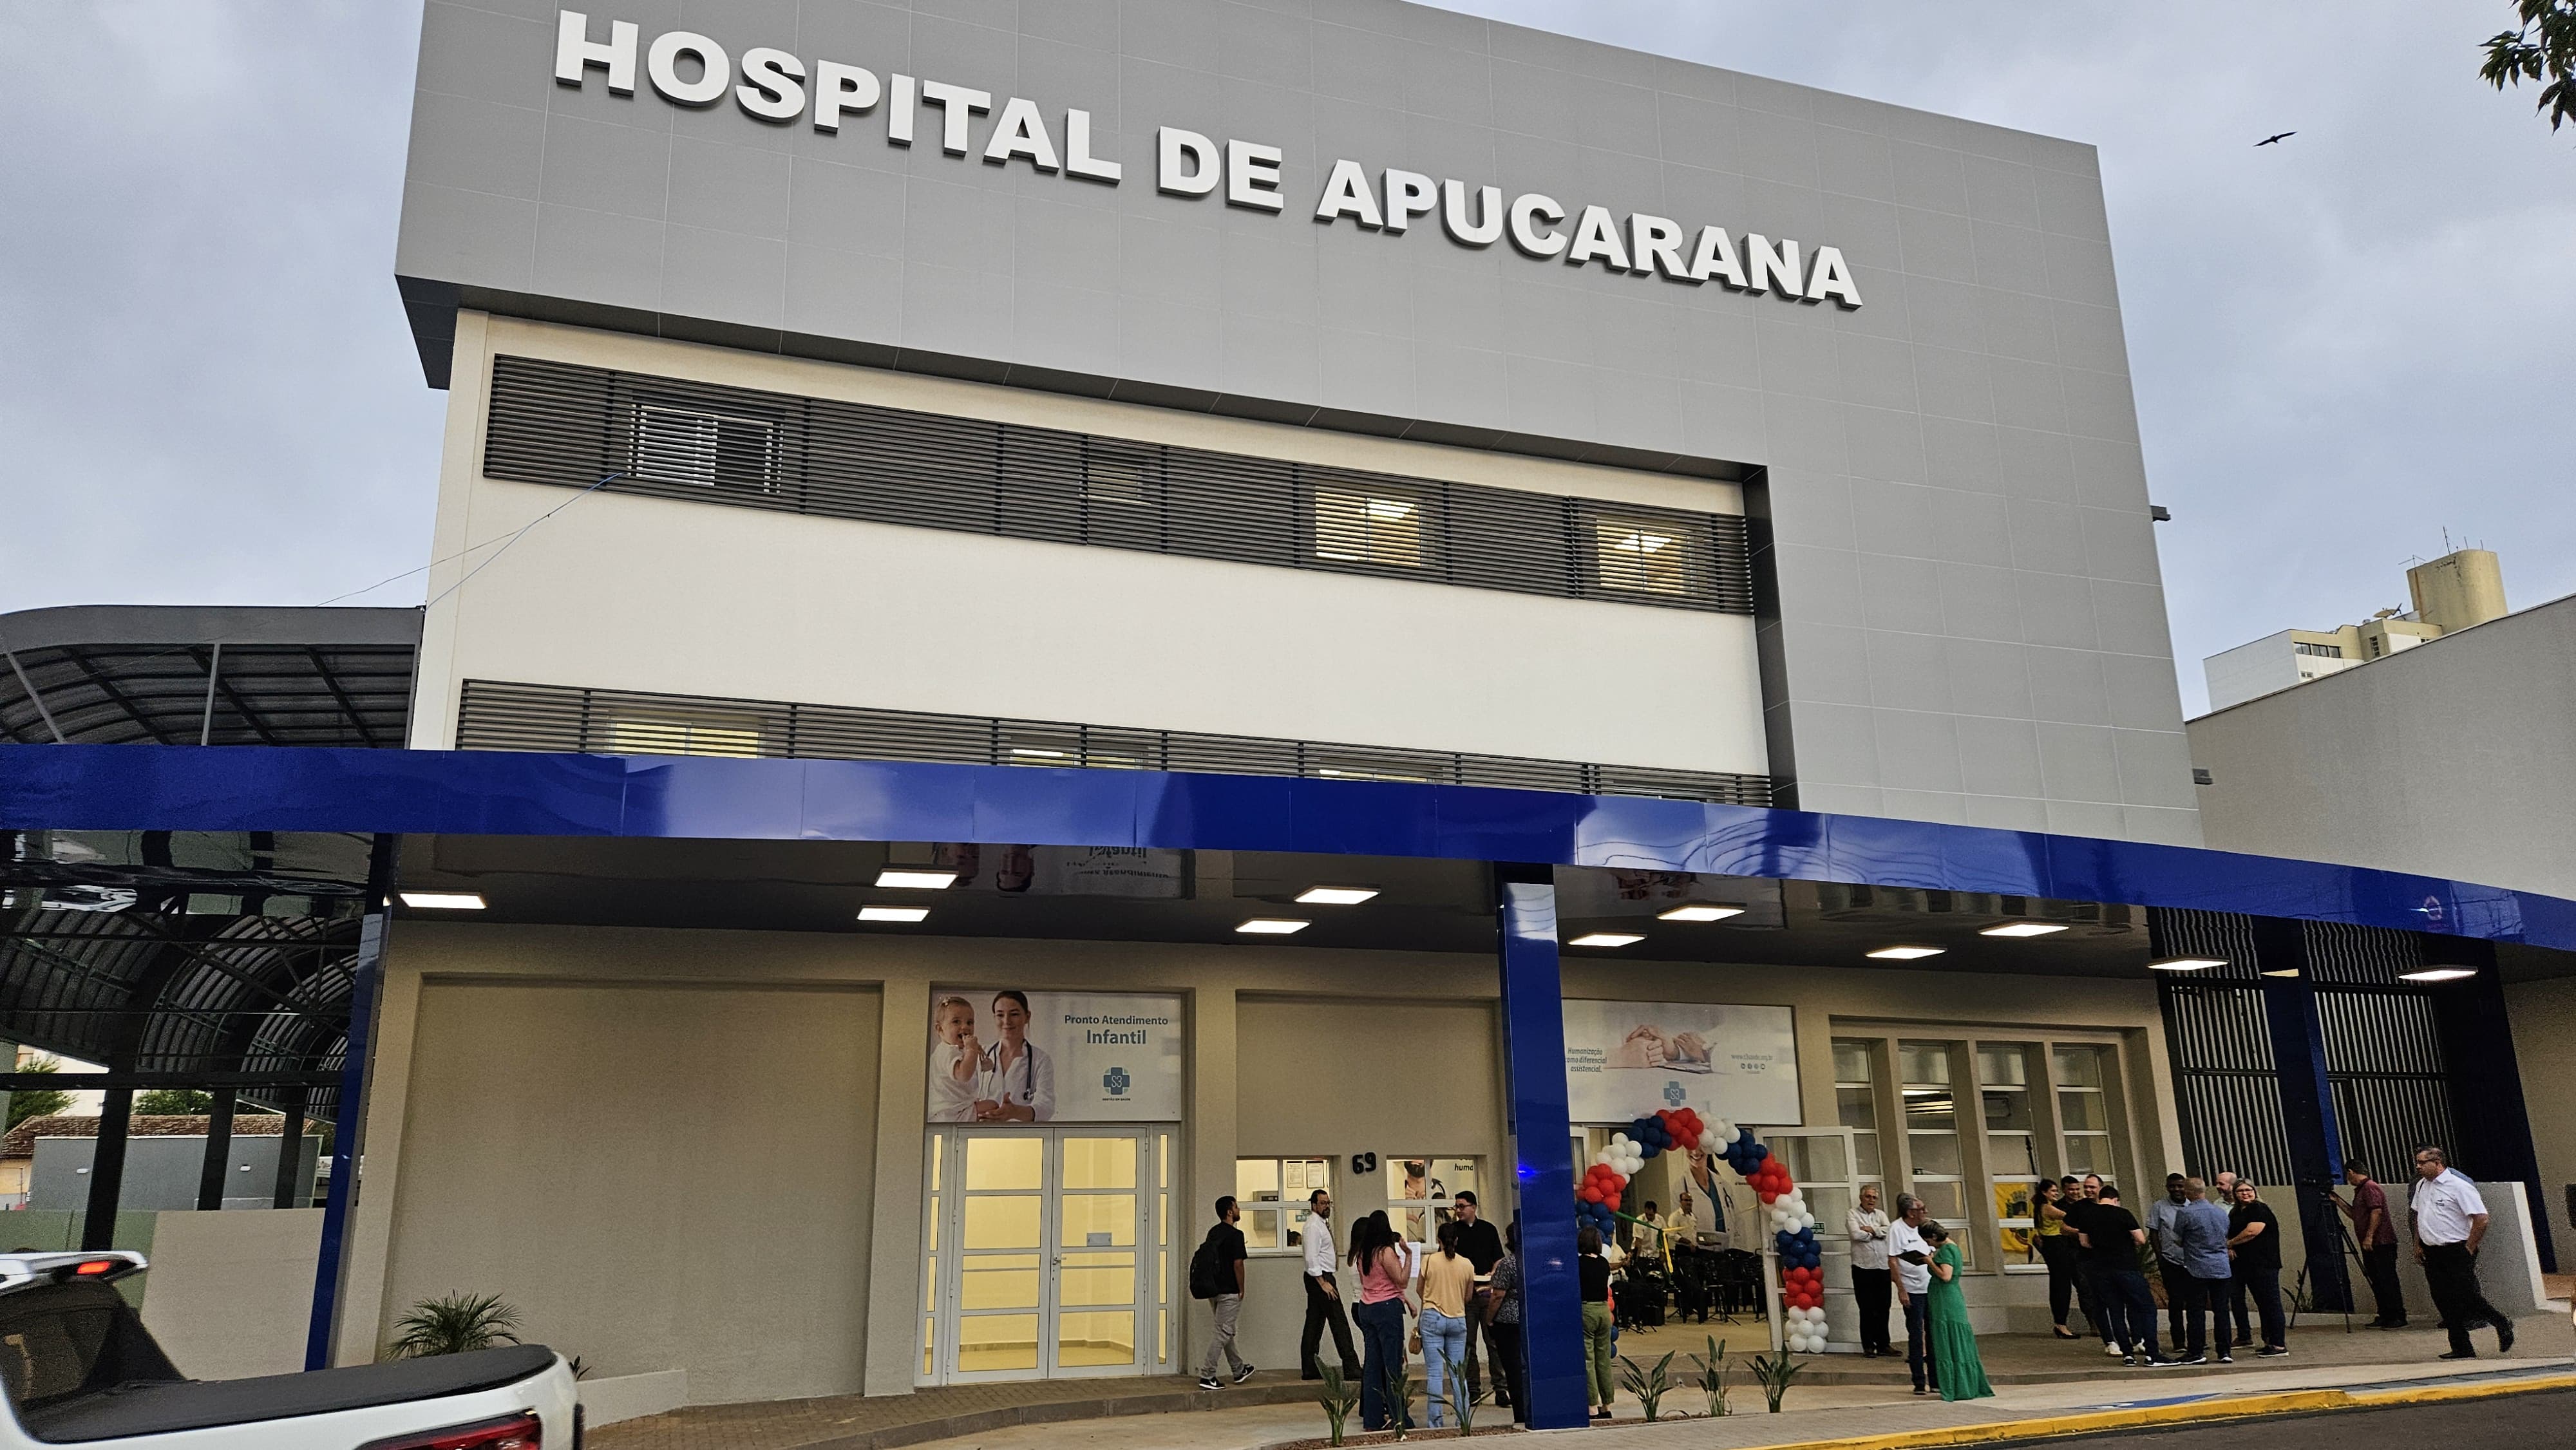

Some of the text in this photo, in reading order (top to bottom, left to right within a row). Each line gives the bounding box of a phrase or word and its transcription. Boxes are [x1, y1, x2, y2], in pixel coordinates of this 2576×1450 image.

[555, 10, 1864, 310] HOSPITAL DE APUCARANA
[1065, 1015, 1168, 1025] Pronto Atendimento
[1086, 1029, 1146, 1044] Infantil
[1567, 1047, 1603, 1056] Humanização
[1111, 1075, 1122, 1088] S3
[1670, 1088, 1680, 1100] S3
[1352, 1152, 1377, 1174] 69
